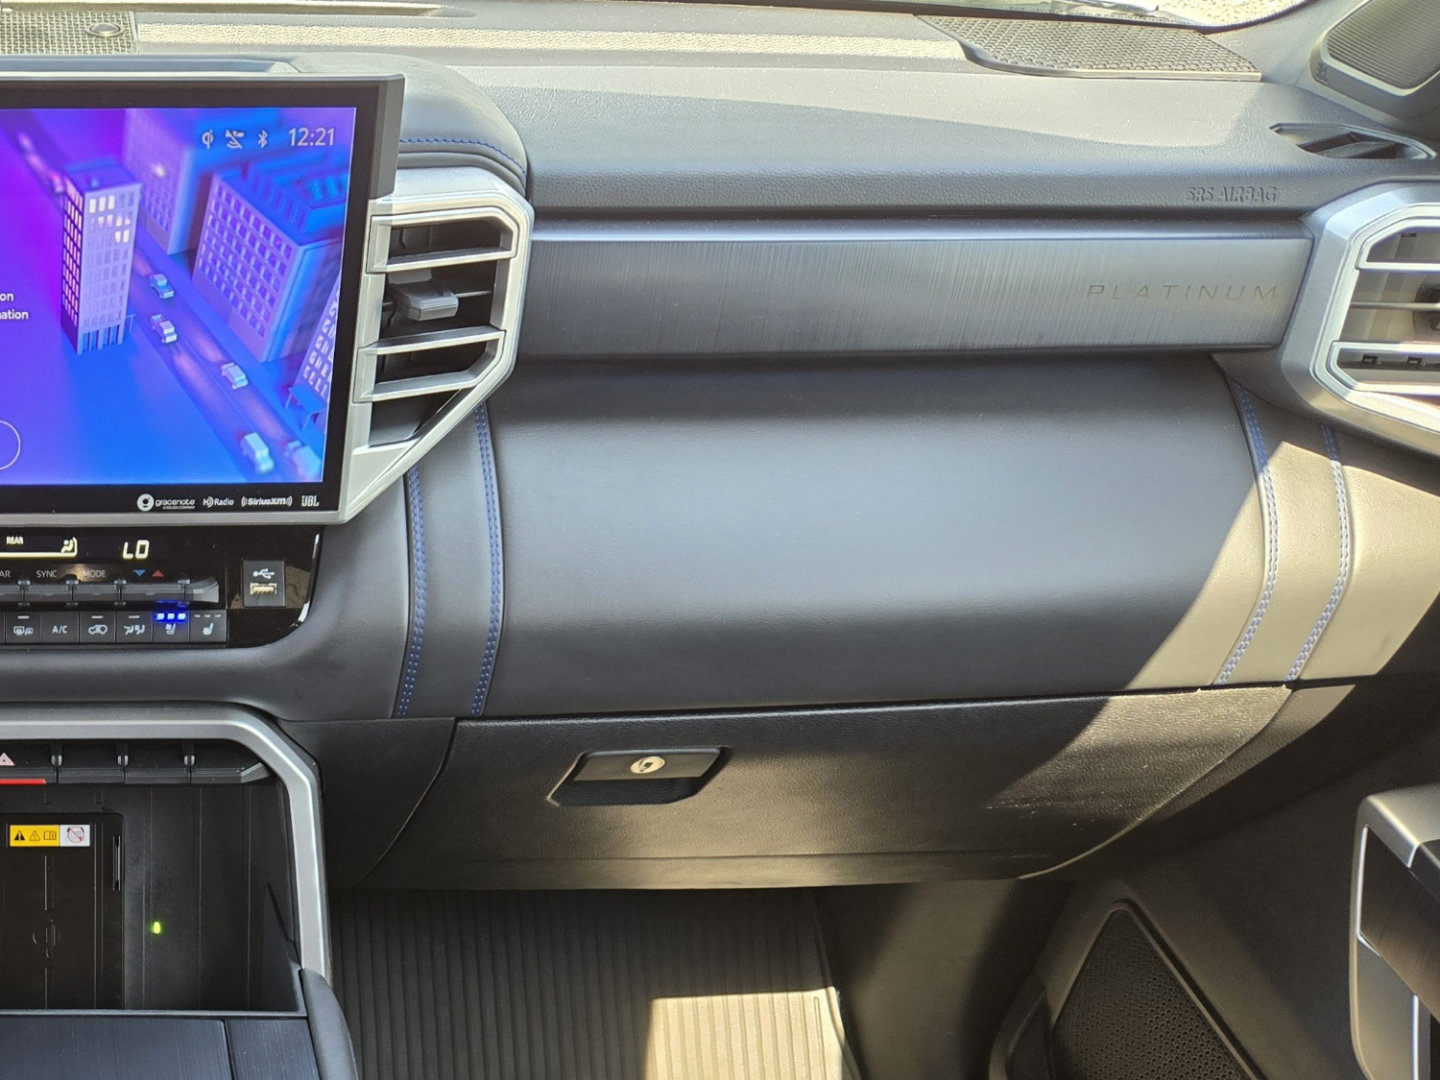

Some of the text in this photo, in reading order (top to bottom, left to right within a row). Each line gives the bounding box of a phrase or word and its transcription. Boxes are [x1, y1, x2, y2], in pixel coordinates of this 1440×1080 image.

[288, 127, 335, 147] 12:21
[1188, 186, 1278, 202] SRS AIRBAG
[1086, 284, 1279, 300] PLATINUM
[301, 495, 320, 507] JBL
[6, 536, 24, 545] REAR
[122, 539, 150, 560] LO
[36, 570, 57, 578] SYNC
[52, 625, 68, 635] A/C
